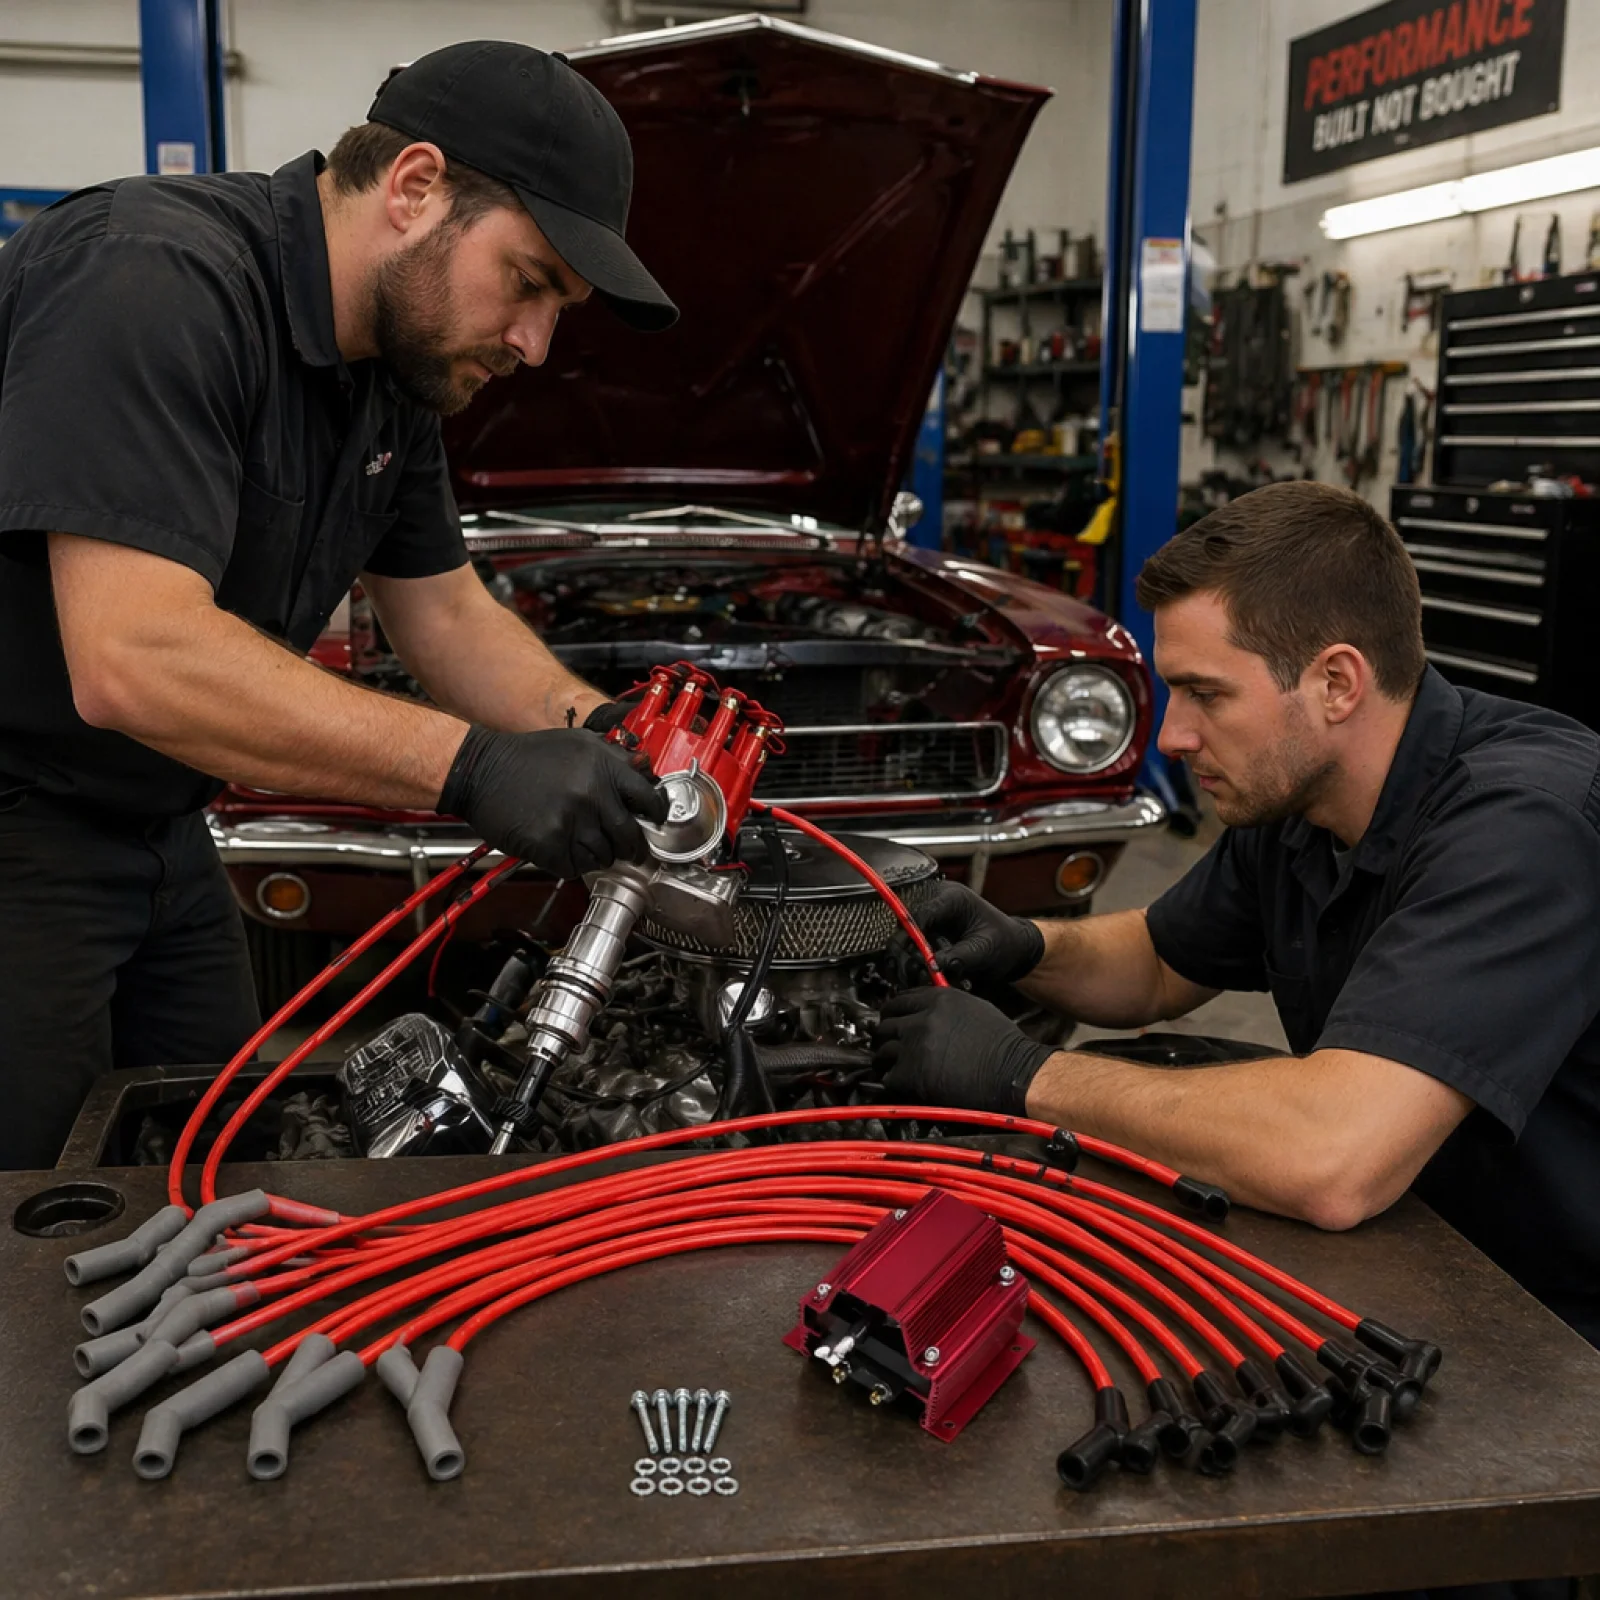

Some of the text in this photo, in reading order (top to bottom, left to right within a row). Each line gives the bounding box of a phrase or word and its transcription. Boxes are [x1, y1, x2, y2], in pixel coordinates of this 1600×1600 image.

[1303, 0, 1534, 110] PERFORMANCE
[1312, 51, 1521, 152] BUILT NOT BOUGHT
